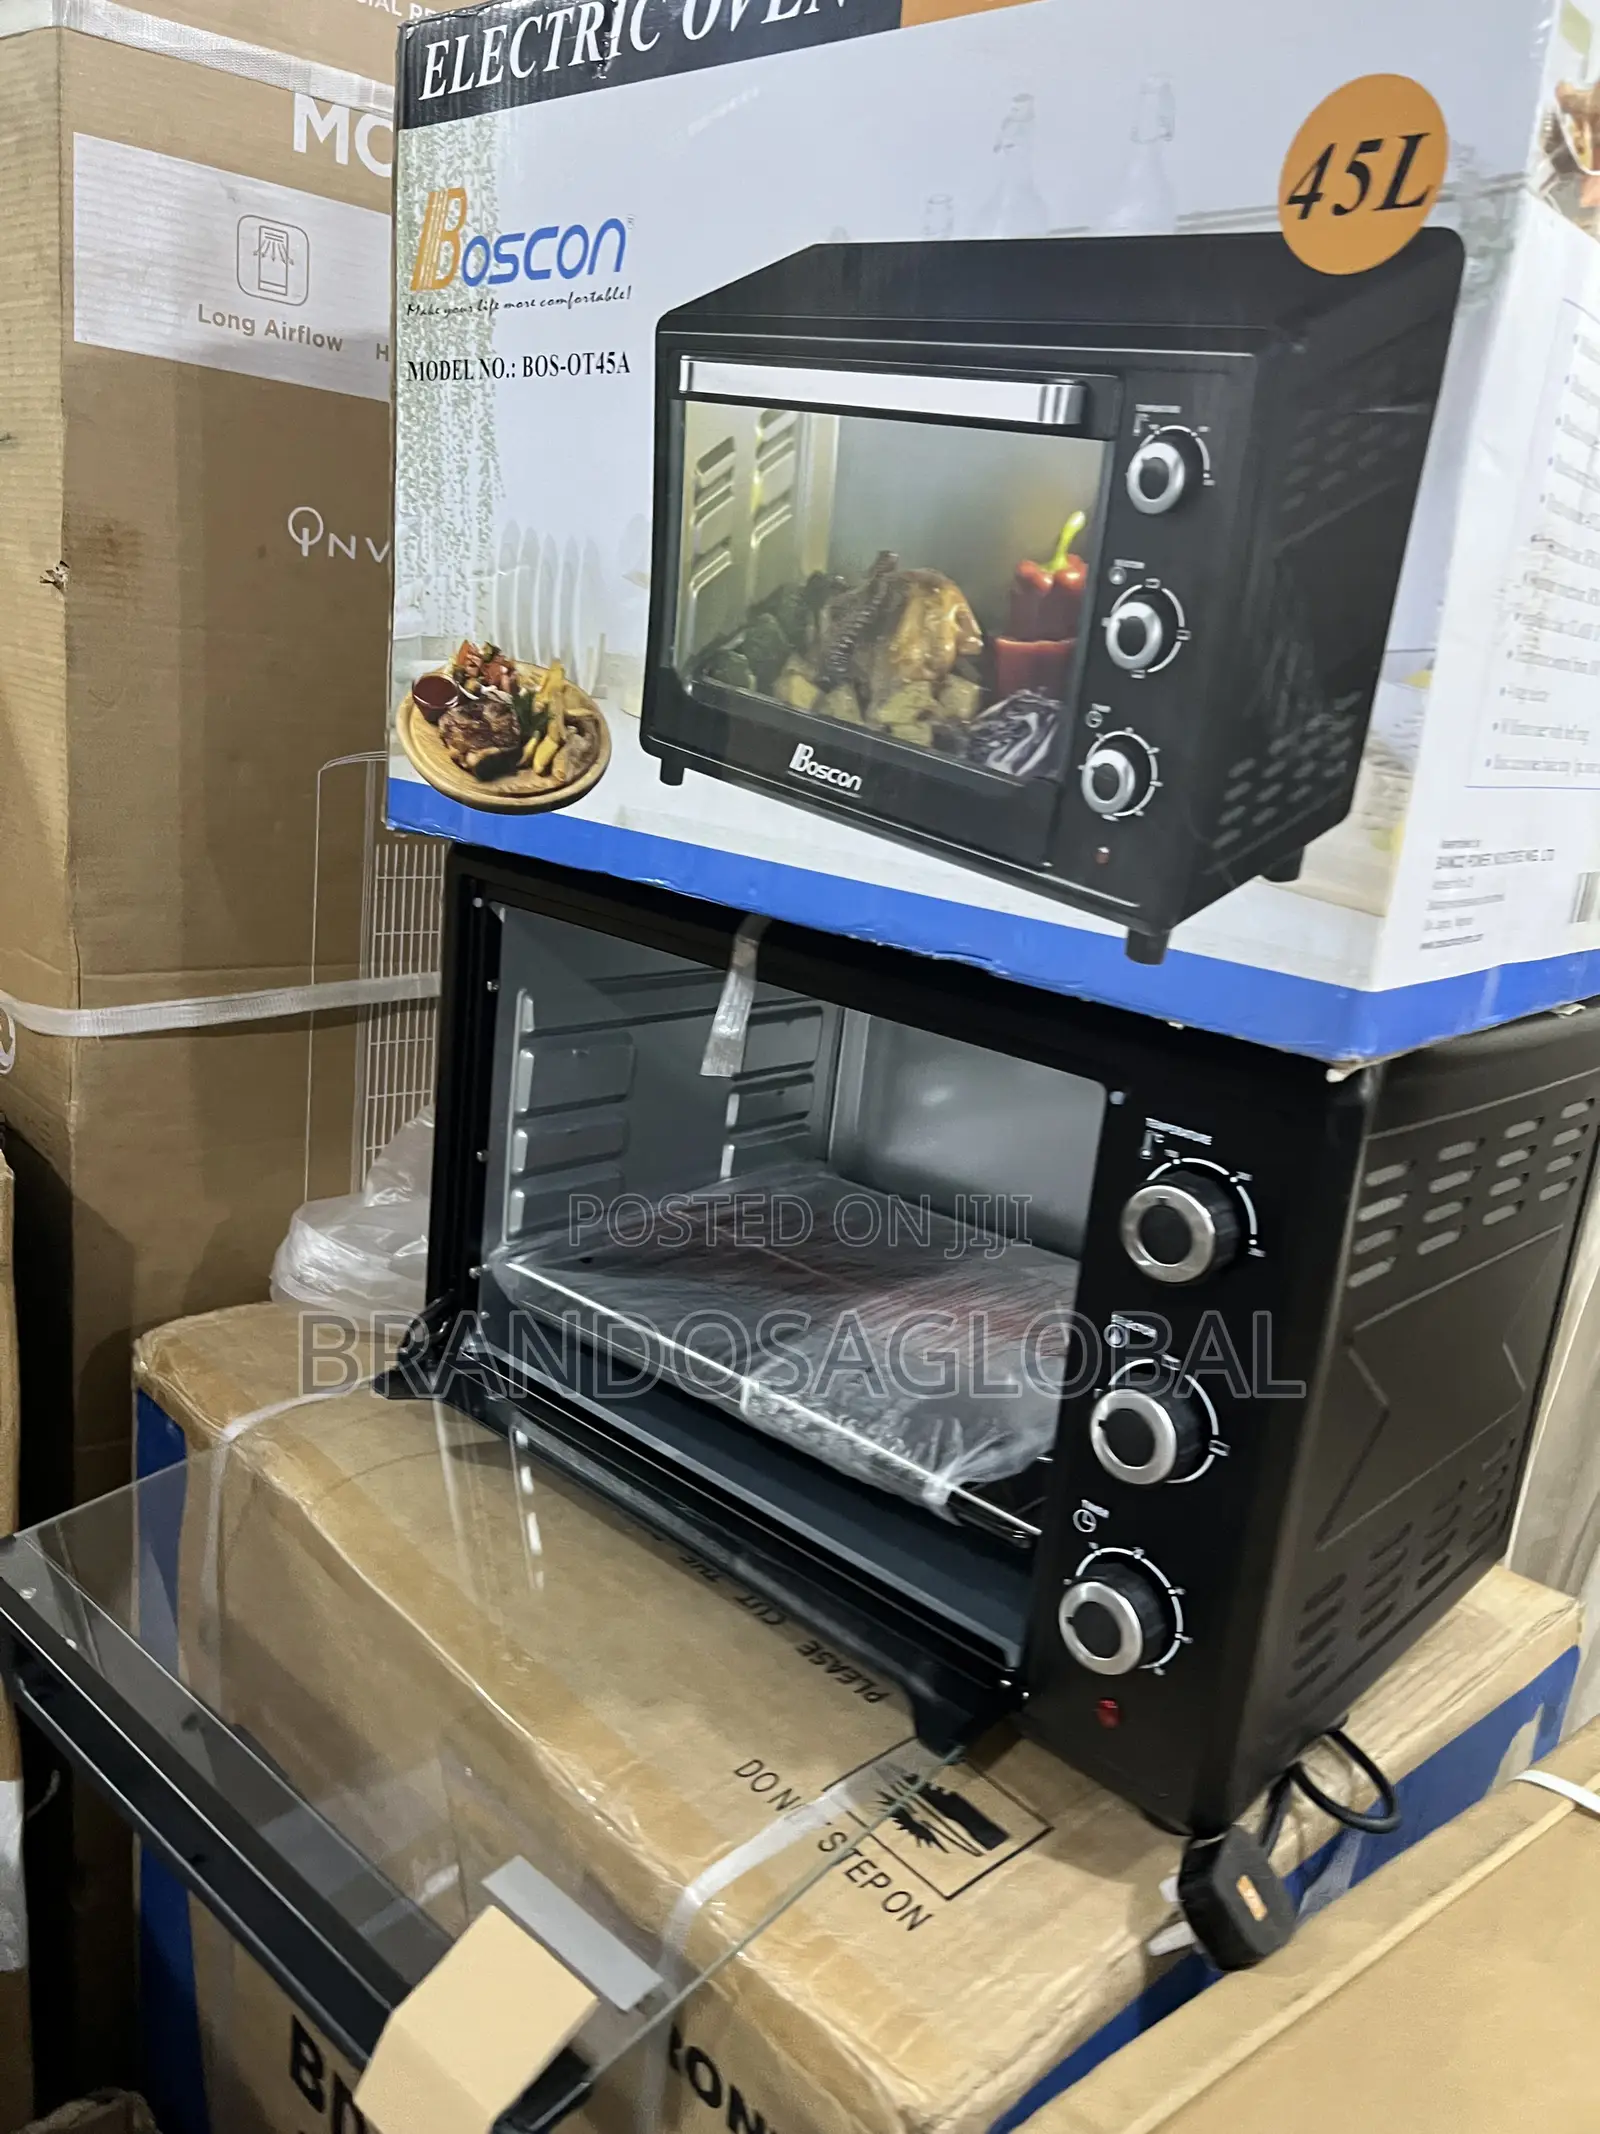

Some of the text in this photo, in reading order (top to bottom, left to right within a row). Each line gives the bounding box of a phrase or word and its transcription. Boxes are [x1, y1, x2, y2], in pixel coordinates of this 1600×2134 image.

[418, 0, 666, 100] ELECTRIC
[1285, 132, 1432, 220] 45L
[198, 304, 343, 352] Long Airflow
[406, 285, 632, 318] Make your life more comfortable!
[407, 351, 631, 382] MODEL NO.: BOS-OT45A
[789, 742, 863, 791] Boscon
[796, 1639, 895, 1703] PLEASE
[817, 1831, 934, 1932] STEP ON
